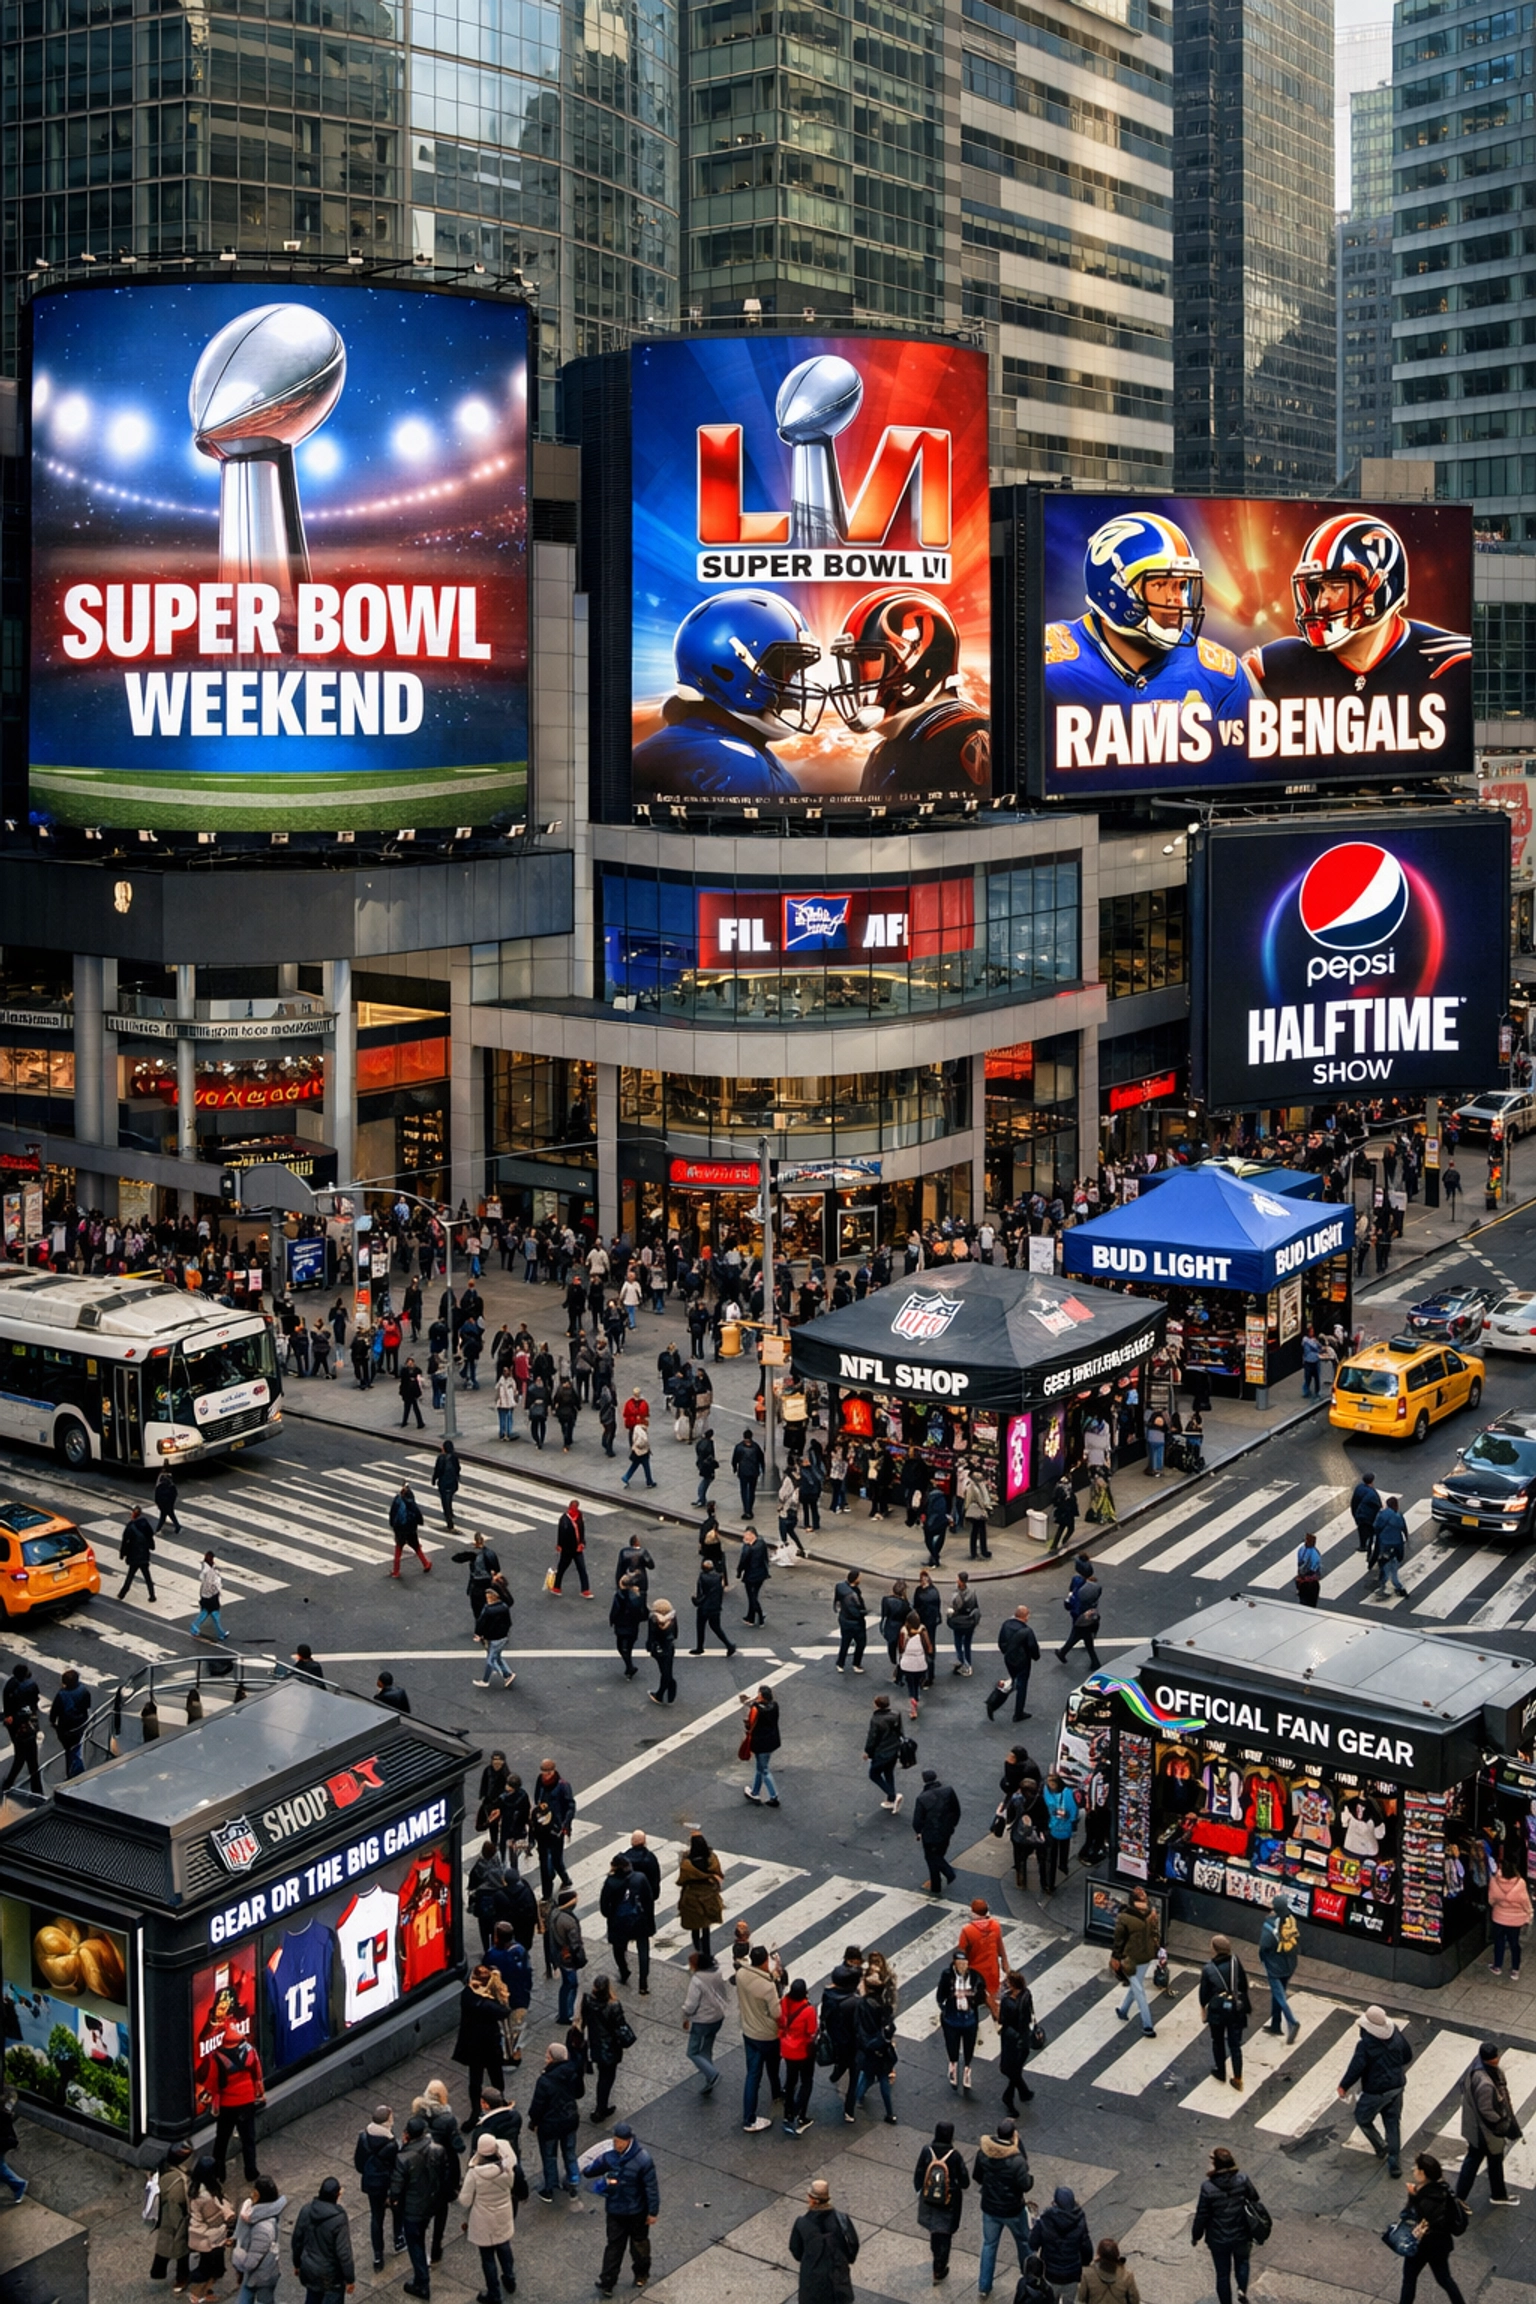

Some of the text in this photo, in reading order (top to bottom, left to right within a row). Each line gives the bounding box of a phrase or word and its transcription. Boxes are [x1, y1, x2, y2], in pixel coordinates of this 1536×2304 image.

[703, 554, 947, 579] SUPER BOWL LVI
[62, 582, 492, 660] SUPER BOWL
[124, 671, 424, 736] WEEKEND
[1056, 701, 1212, 768] RAMS
[1249, 693, 1446, 758] BENGALS
[719, 918, 771, 952] FIL
[1307, 947, 1395, 986] pepsi
[1248, 996, 1459, 1066] HALFTIME
[1312, 1058, 1393, 1084] SHOW
[1092, 1245, 1232, 1281] BUD LIGHT
[1275, 1239, 1305, 1276] BUD
[839, 1354, 969, 1396] NFL SHOP
[1155, 1685, 1270, 1734] OFFICIAL
[1276, 1712, 1330, 1749] FAN
[1338, 1727, 1415, 1769] GEAR
[210, 1899, 267, 1944] GEAR
[304, 1855, 343, 1896] THE
[347, 1837, 379, 1876] BIG
[384, 1799, 447, 1857] GAME!
